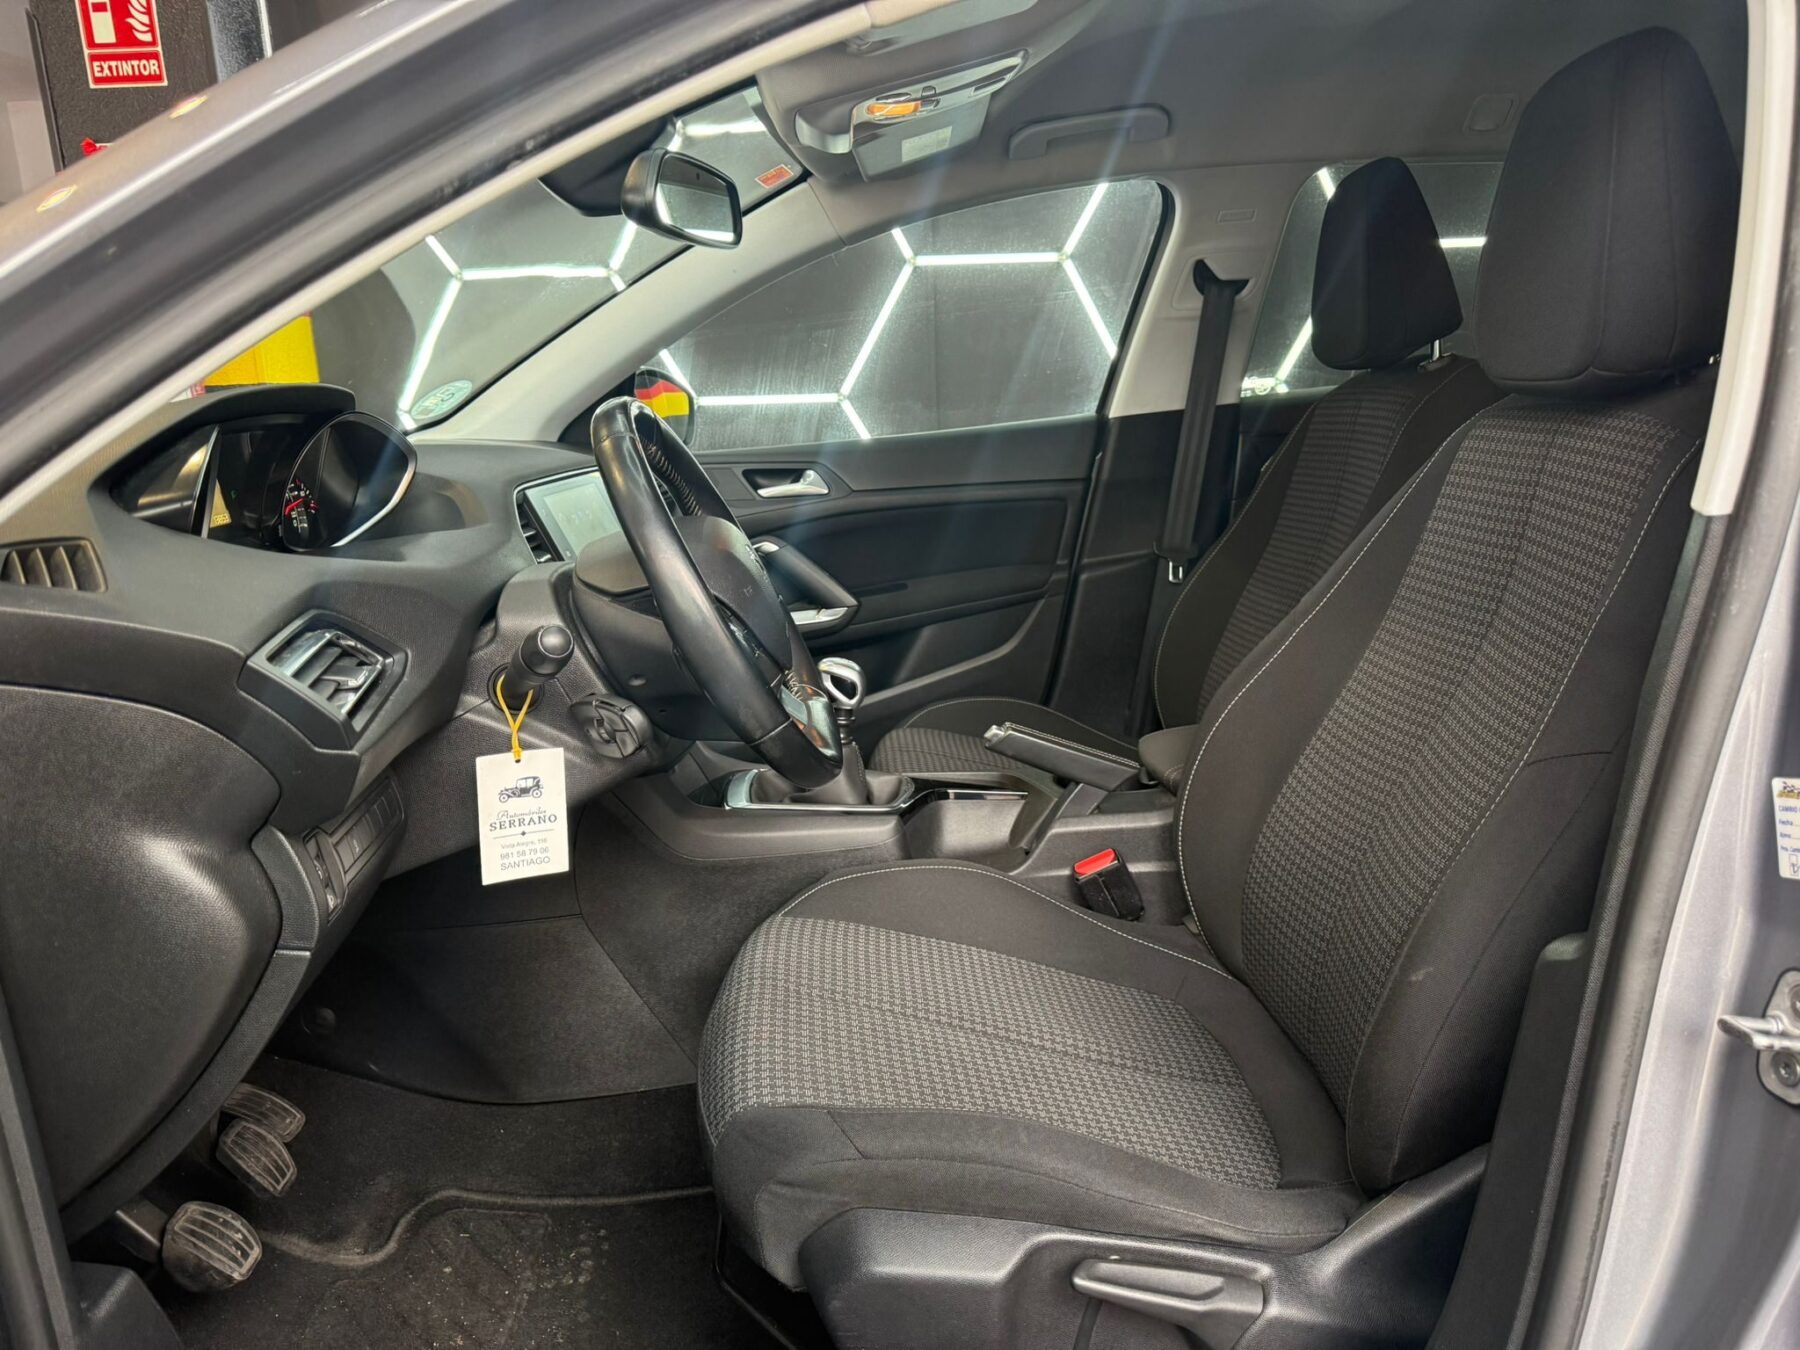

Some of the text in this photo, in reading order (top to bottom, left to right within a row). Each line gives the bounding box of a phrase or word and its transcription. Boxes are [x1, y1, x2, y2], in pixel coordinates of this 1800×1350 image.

[92, 59, 160, 78] EXTINTOR
[489, 814, 558, 832] SERRANO
[500, 851, 514, 861] 981
[528, 847, 538, 856] 79
[500, 855, 551, 871] SANTIAGO
